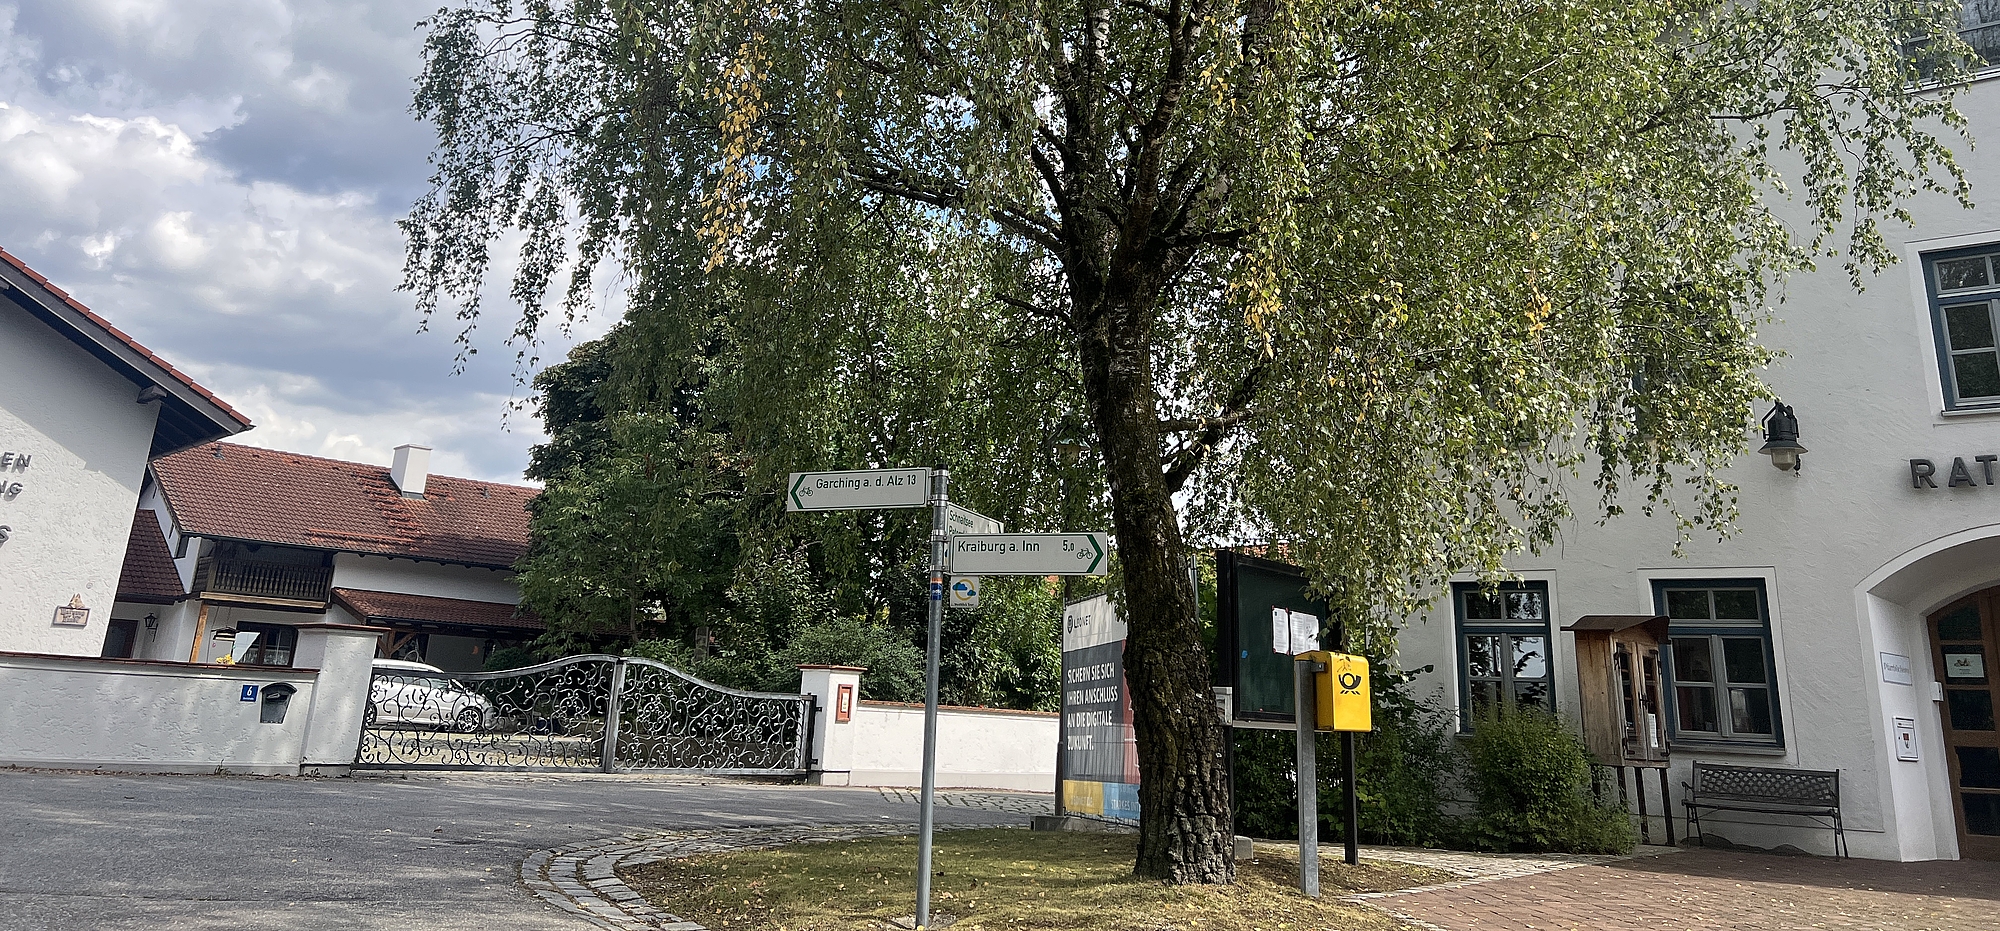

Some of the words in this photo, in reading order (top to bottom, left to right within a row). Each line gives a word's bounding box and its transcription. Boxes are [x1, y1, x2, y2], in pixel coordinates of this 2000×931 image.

[1909, 454, 1998, 488] RAT
[816, 477, 860, 490] Garching
[863, 479, 872, 487] a.
[875, 476, 884, 487] d.
[887, 475, 903, 487] Alz
[907, 474, 917, 486] 13
[957, 540, 1006, 554] Kraiburg
[1009, 543, 1019, 552] a.
[1022, 540, 1040, 552] Inn
[1067, 666, 1091, 684] SICHERN
[1091, 664, 1100, 681] SIE
[1101, 662, 1115, 680] SICH
[246, 685, 253, 697] 6
[1067, 689, 1084, 705] IHREN
[1084, 685, 1118, 704] ANSCHLUSS
[1067, 712, 1075, 728] AN
[1076, 711, 1086, 728] DIE
[1086, 710, 1113, 727] DIGITALE
[1067, 735, 1094, 751] ZUKUNFT.
